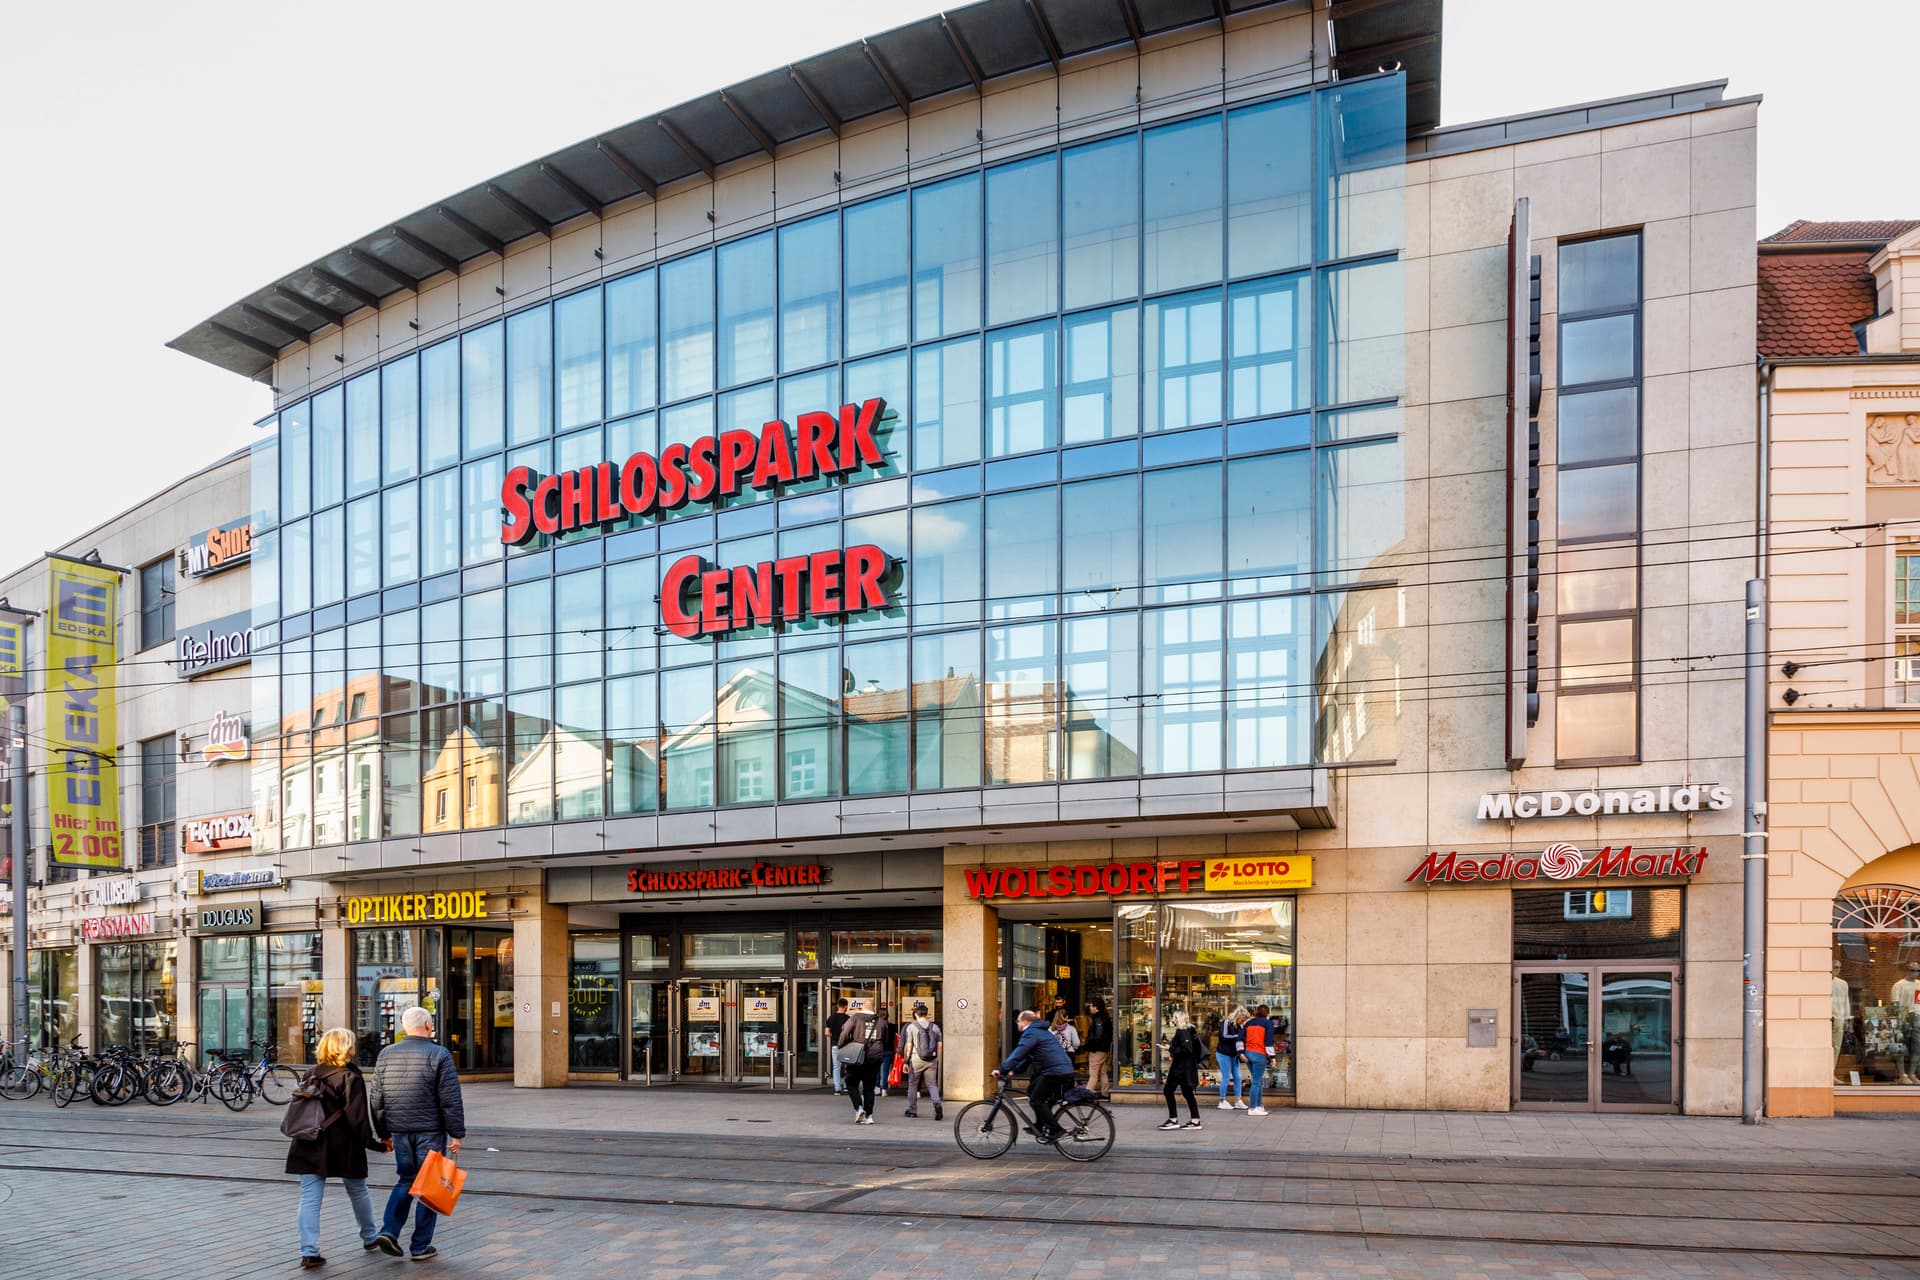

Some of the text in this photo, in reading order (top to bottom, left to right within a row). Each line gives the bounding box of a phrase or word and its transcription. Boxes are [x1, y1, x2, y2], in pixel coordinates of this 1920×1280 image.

[501, 397, 888, 546] SCHLOSSPARK
[660, 544, 894, 639] CENTER
[57, 622, 107, 637] EDEKA
[64, 655, 101, 806] EDEKA
[210, 710, 241, 745] dm
[1476, 784, 1734, 820] McDonald's
[54, 813, 117, 831] Hier im
[964, 861, 1202, 899] WOLSDORFF
[1233, 861, 1290, 877] LOTTO
[1405, 846, 1710, 883] Media Markt
[202, 908, 253, 927] DOUGLAS
[347, 890, 488, 924] OPTIKER BODE
[83, 913, 151, 939] ROSSMANN
